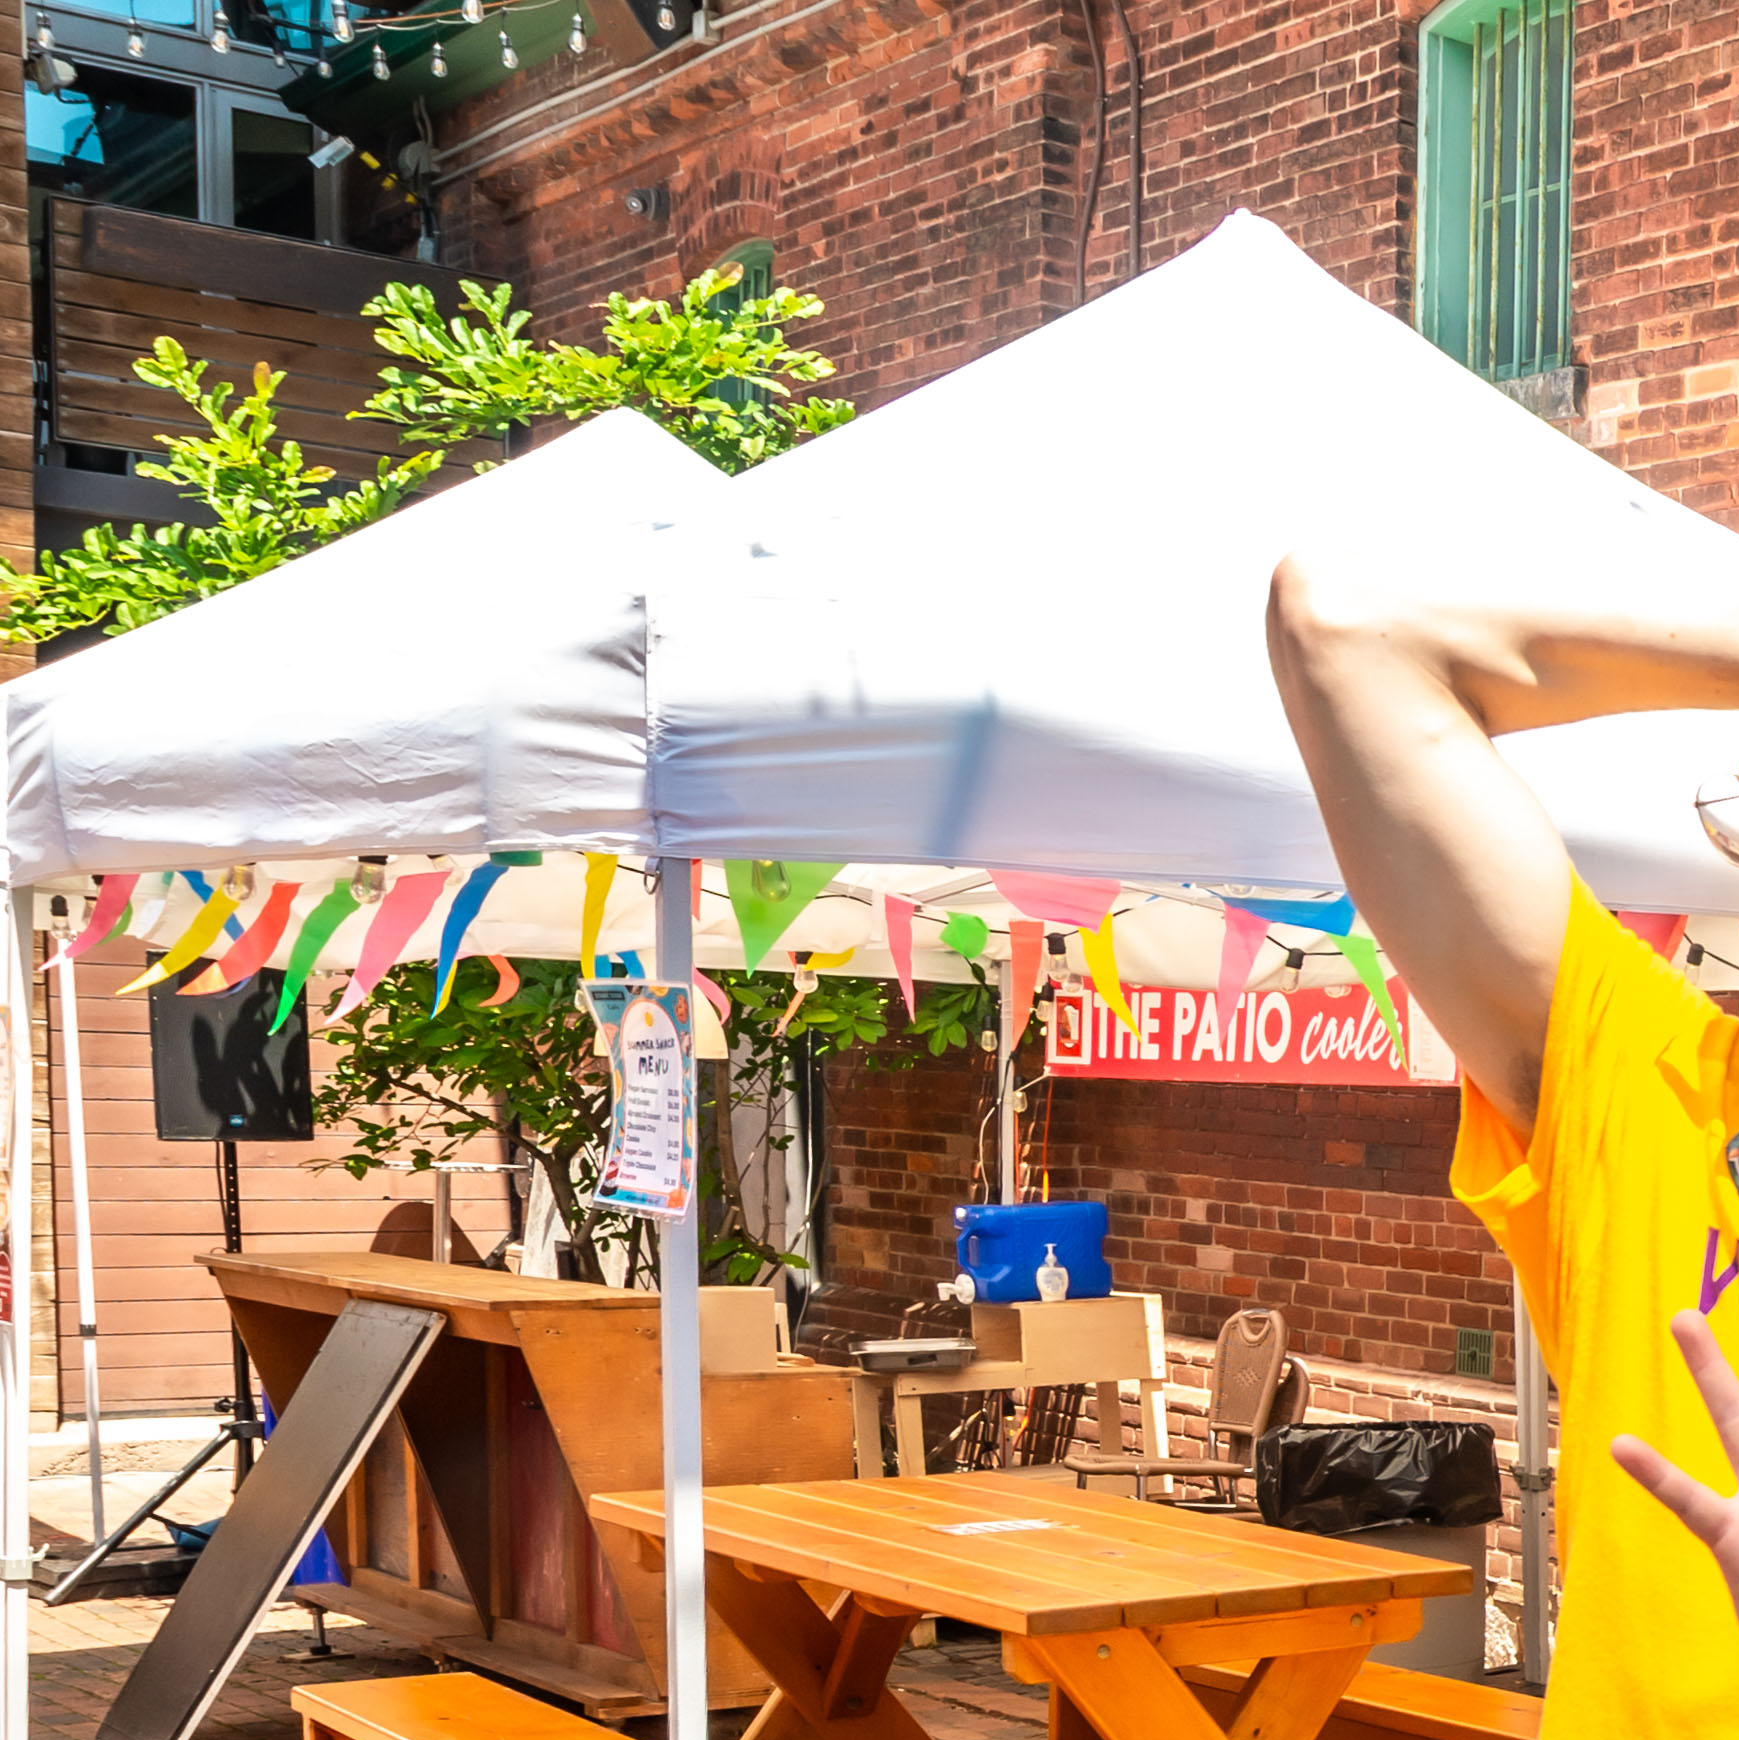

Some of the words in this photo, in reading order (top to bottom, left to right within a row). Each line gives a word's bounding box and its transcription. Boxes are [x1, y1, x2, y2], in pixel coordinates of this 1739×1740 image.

[1093, 991, 1160, 1061] THE
[1172, 991, 1291, 1063] PATIO
[656, 1037, 675, 1049] SNACK
[638, 1055, 669, 1076] MENU
